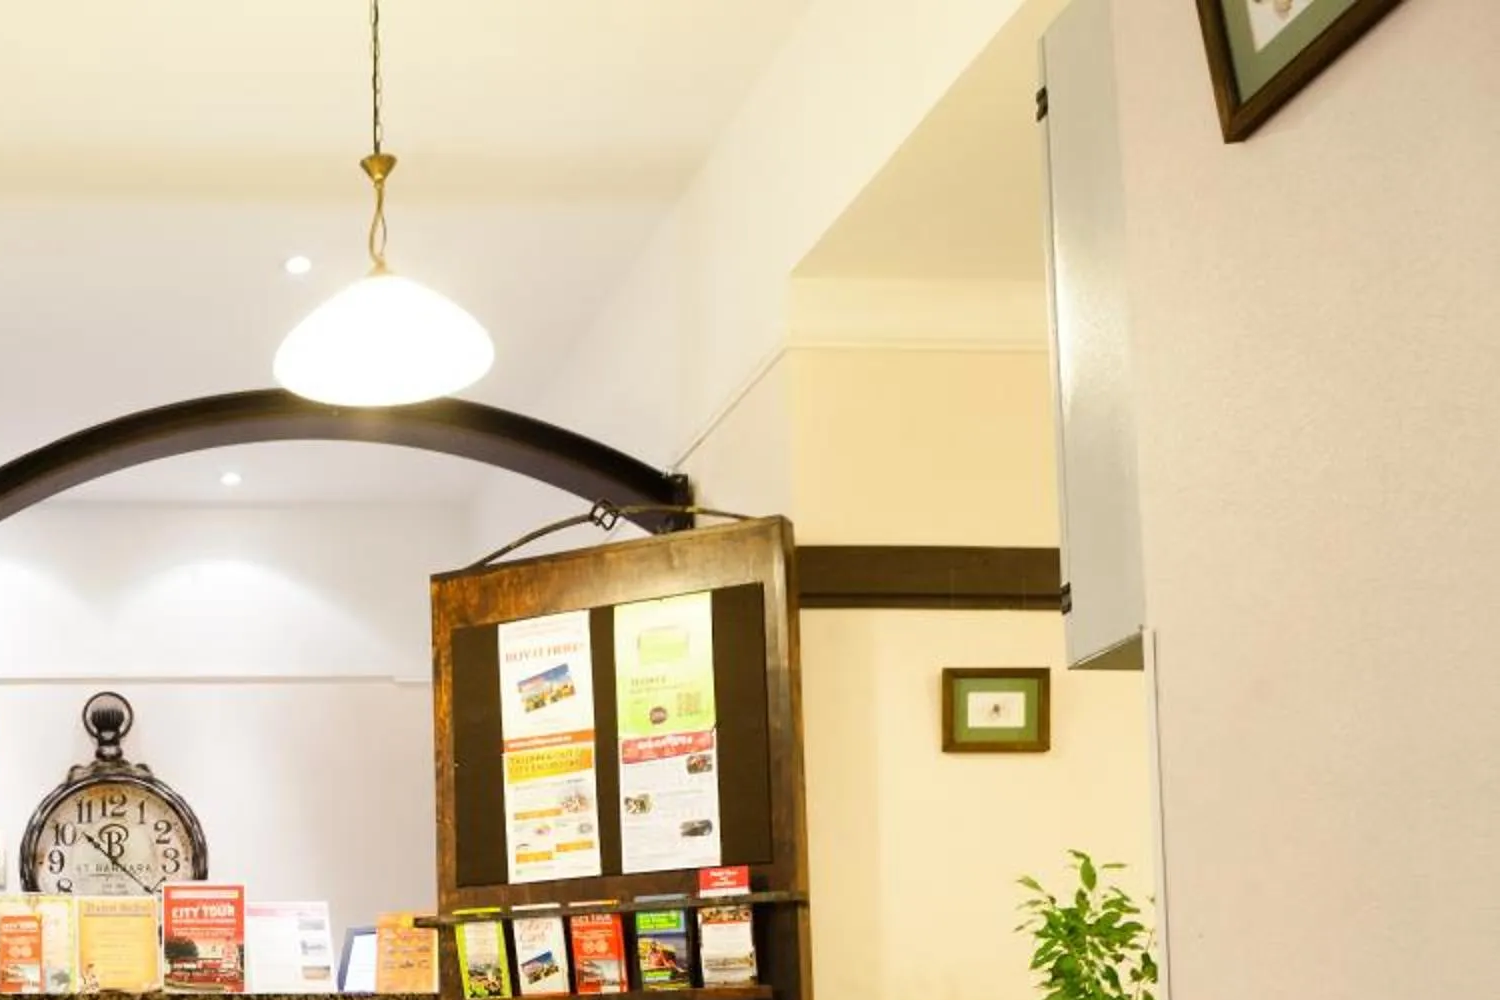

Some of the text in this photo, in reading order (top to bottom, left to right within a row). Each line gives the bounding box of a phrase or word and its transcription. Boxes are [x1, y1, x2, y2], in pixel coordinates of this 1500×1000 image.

[77, 801, 92, 824] 11
[101, 796, 127, 817] 12
[139, 801, 146, 825] 1
[54, 823, 77, 846] 10
[99, 823, 129, 860] B
[154, 820, 172, 844] 2
[49, 850, 64, 874] 9
[162, 848, 180, 873] 3
[171, 903, 236, 919] CITY TOUR
